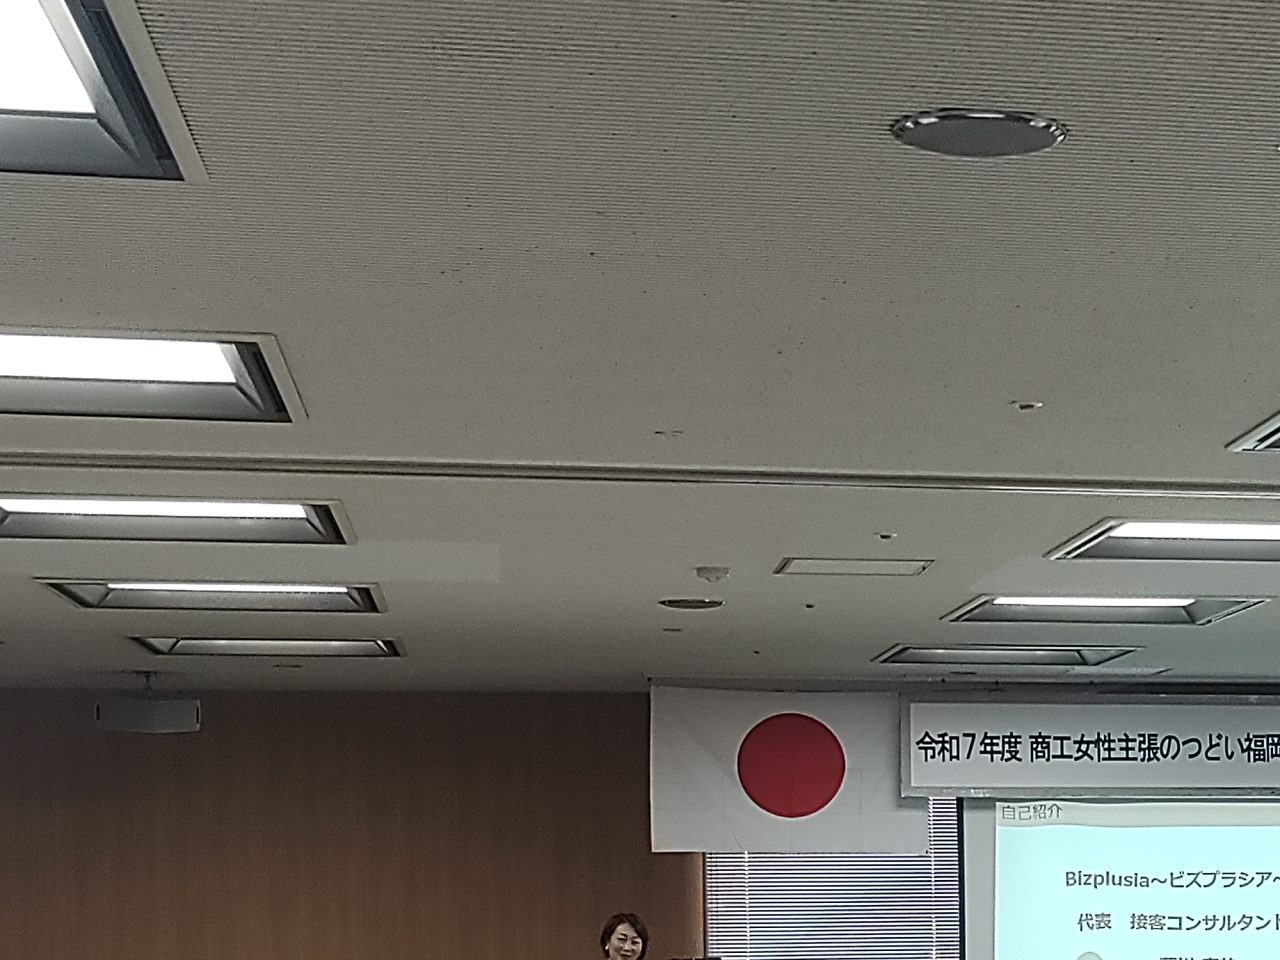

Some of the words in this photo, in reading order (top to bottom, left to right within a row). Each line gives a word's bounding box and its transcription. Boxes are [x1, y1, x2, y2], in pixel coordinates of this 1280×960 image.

[914, 731, 1023, 763] 令和7年度
[1001, 803, 1063, 821] 自己紹介
[1077, 913, 1112, 931] 代表
